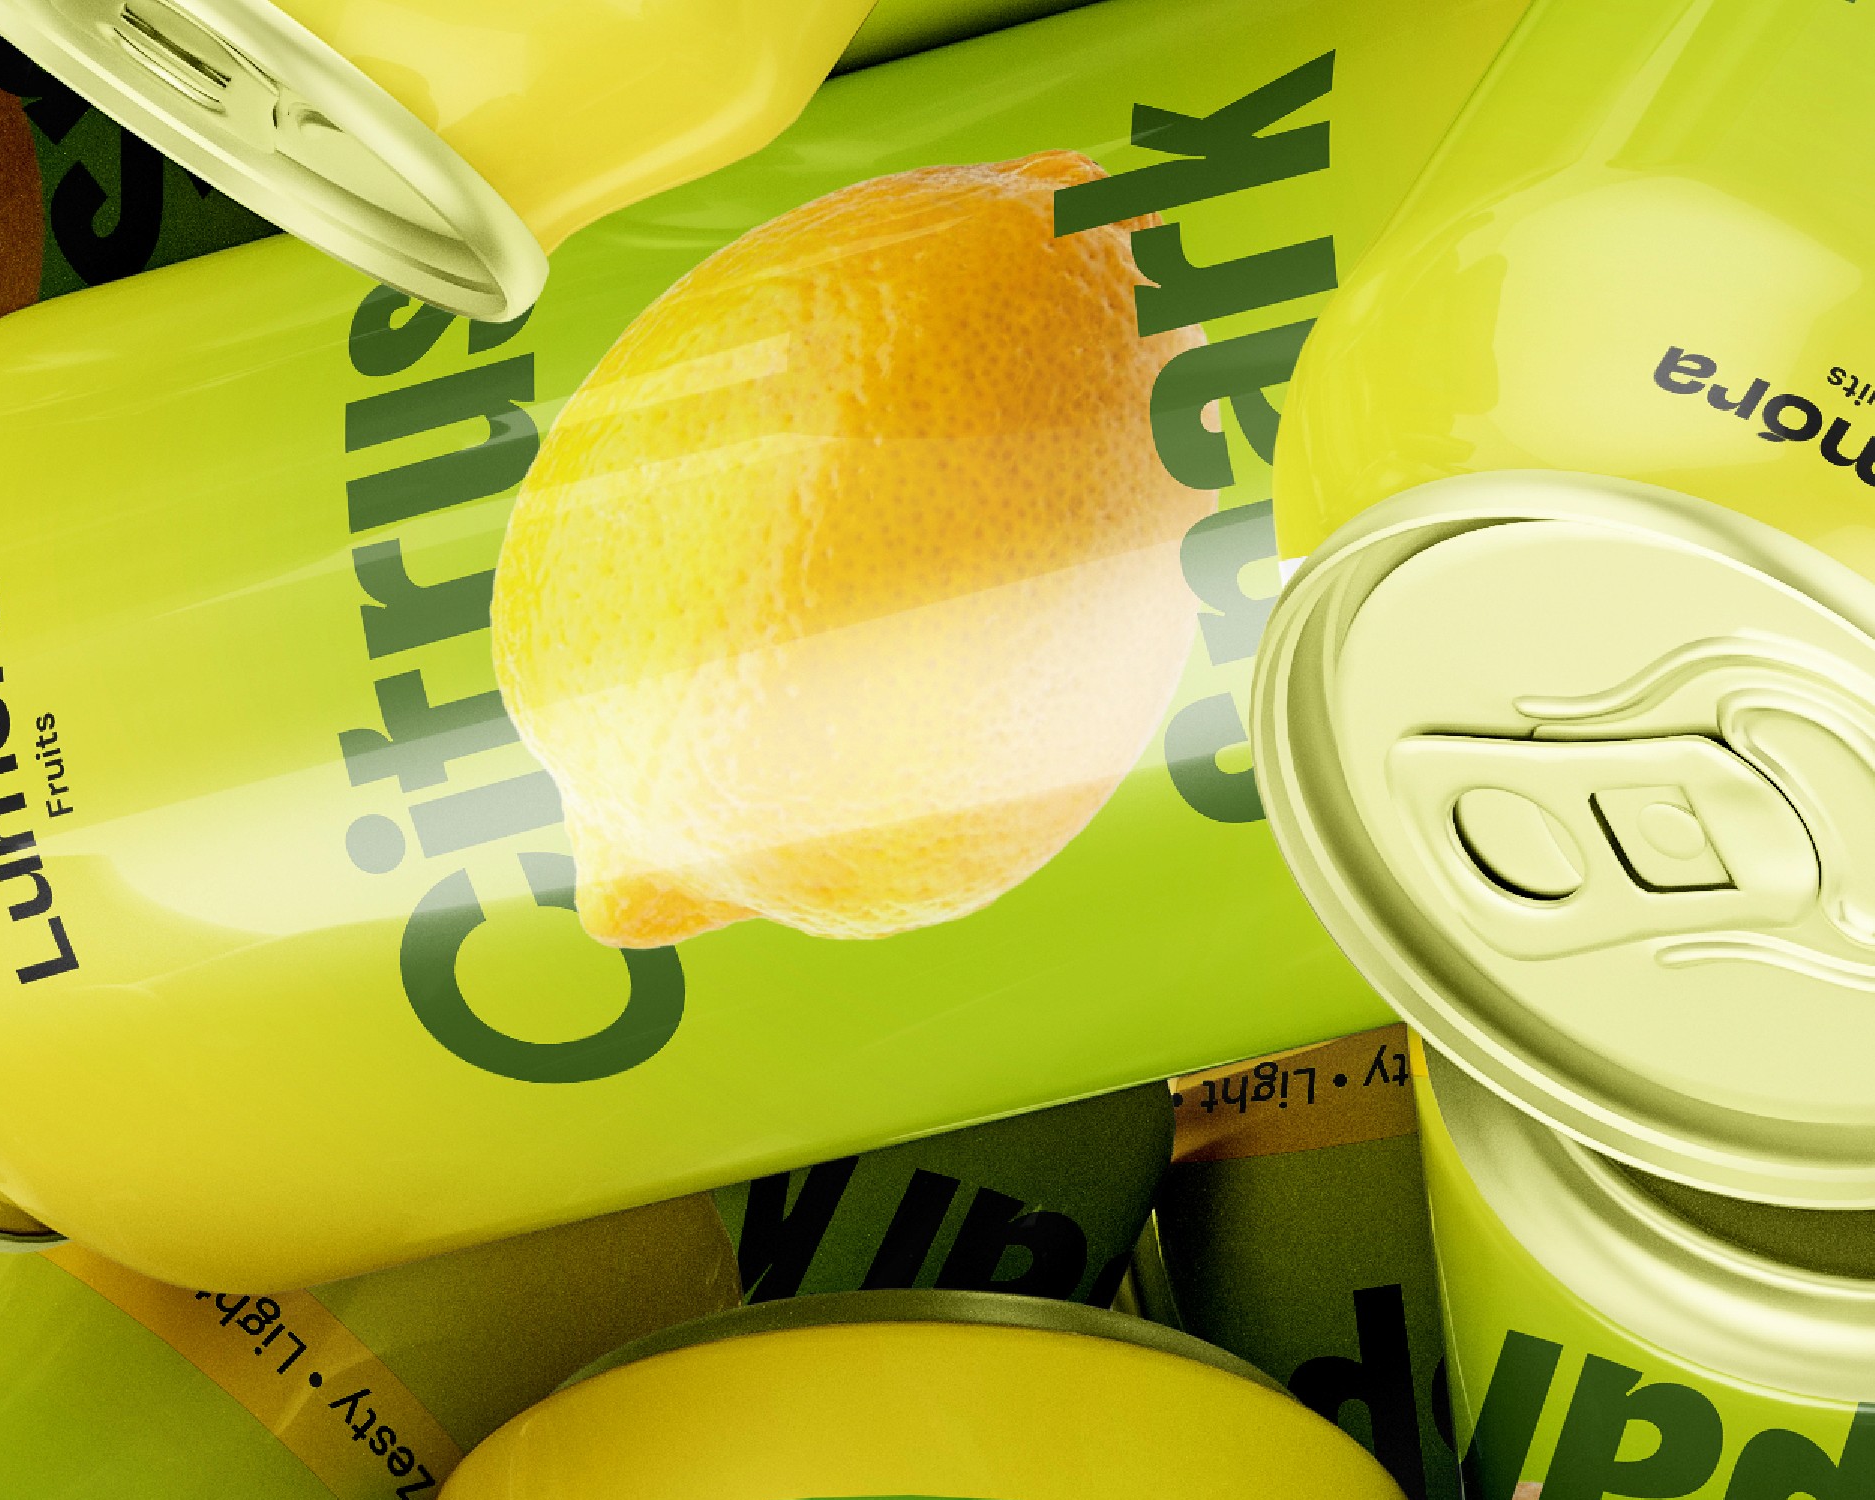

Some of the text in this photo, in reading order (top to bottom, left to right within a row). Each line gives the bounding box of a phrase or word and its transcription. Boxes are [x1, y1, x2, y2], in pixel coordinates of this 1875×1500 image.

[1652, 345, 1875, 488] móra
[32, 711, 75, 817] Fruits
[1201, 1066, 1318, 1113] Light
[195, 1288, 308, 1376] Ligh
